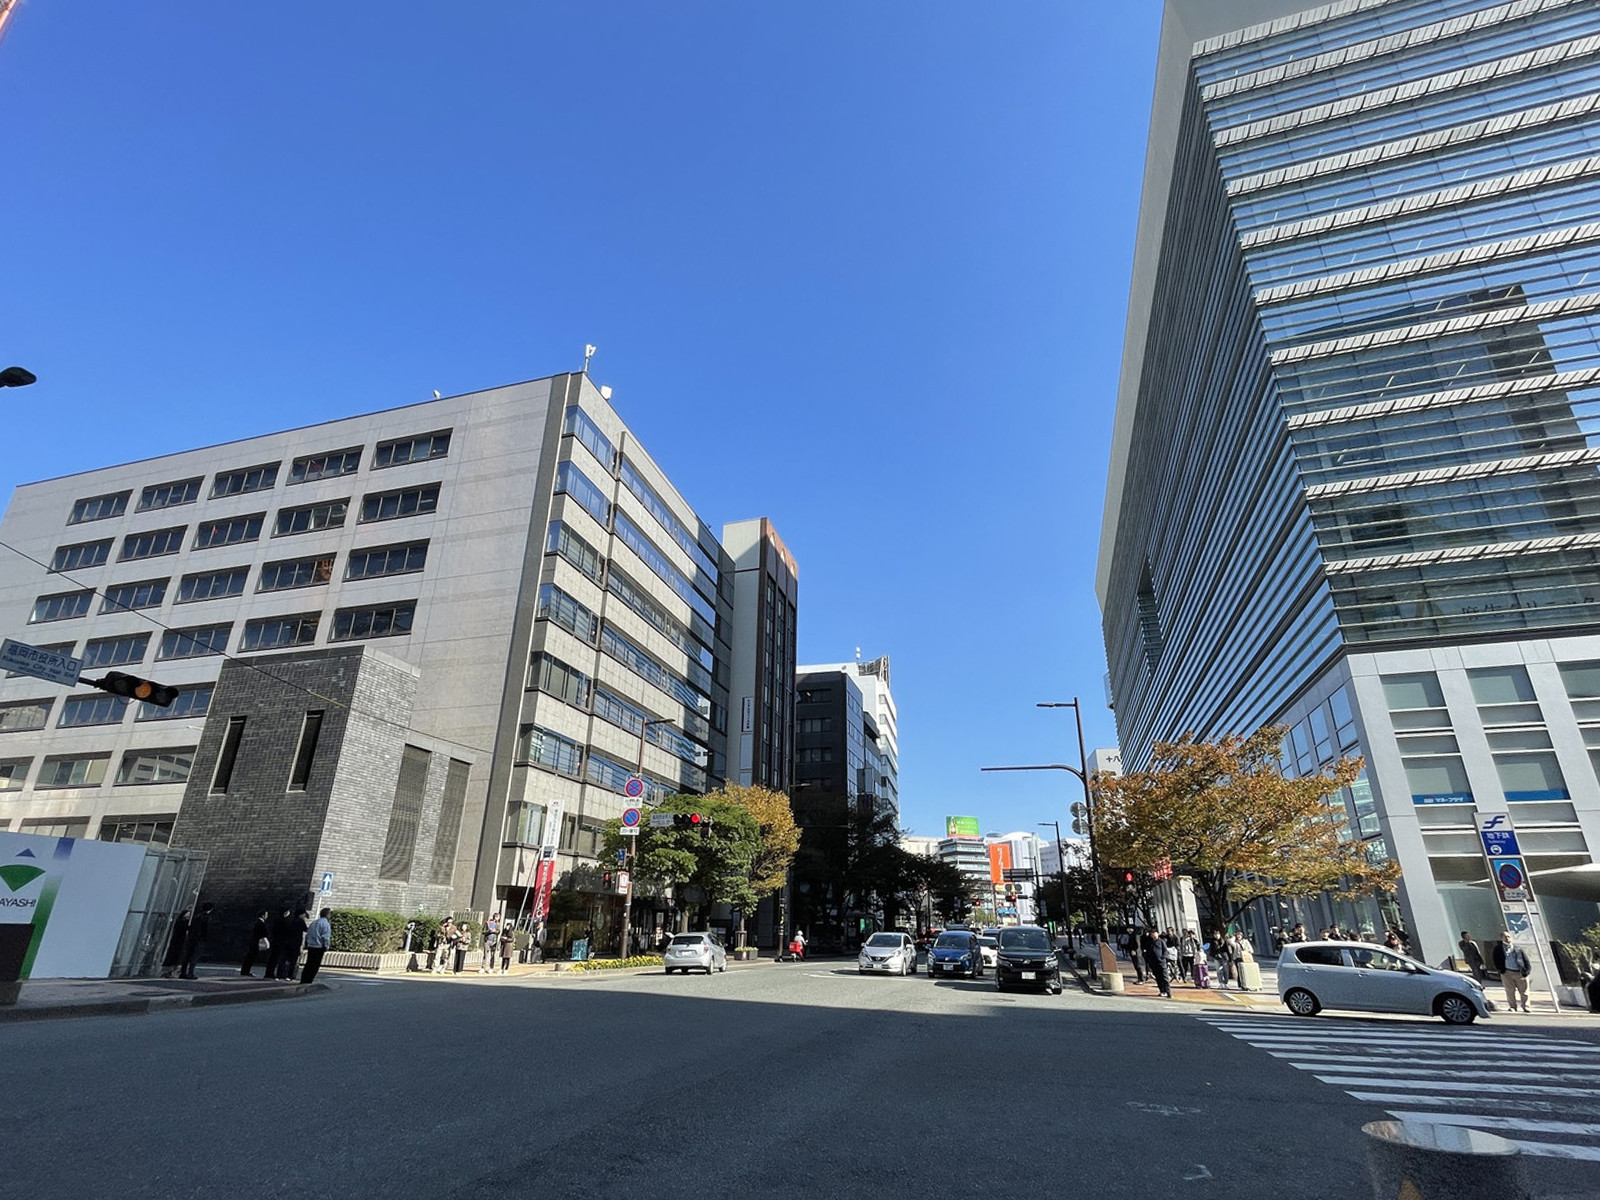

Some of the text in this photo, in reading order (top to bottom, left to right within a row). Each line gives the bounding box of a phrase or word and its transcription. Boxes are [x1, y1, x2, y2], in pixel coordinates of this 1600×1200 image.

[8, 644, 77, 672] 福岡市役所入口
[1486, 832, 1510, 840] 地下鉄
